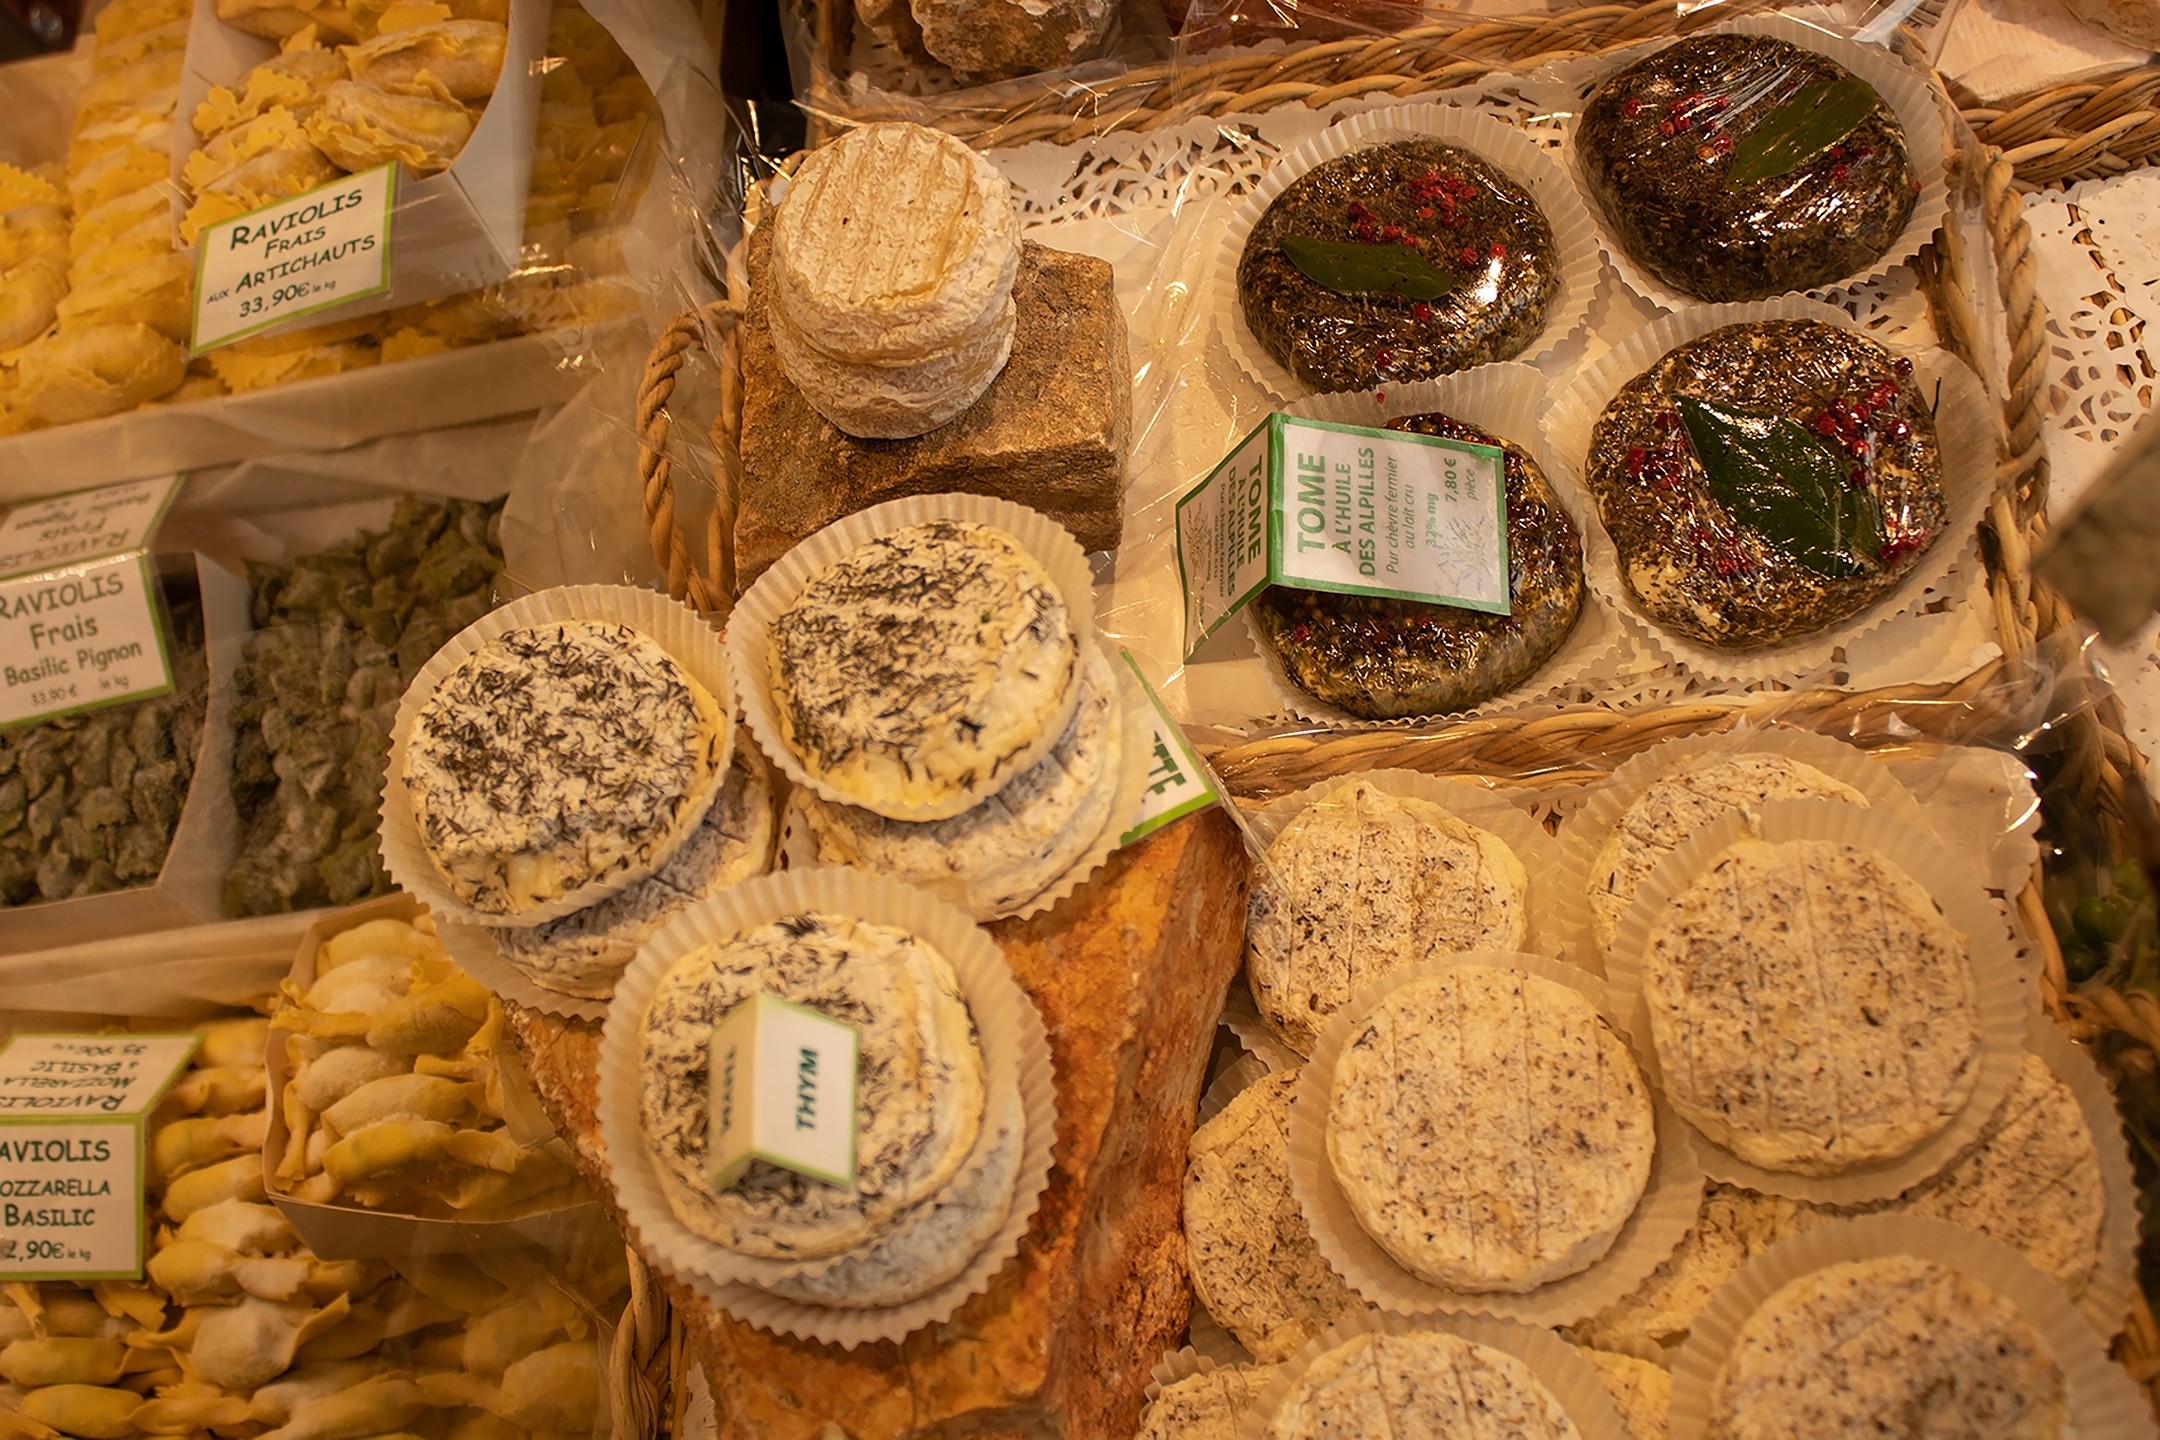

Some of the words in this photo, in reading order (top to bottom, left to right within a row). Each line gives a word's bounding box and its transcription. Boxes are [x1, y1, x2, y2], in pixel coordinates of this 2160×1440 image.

[230, 190, 362, 250] RAVIOLIS
[264, 226, 326, 259] FRAIS
[207, 289, 230, 304] AUX
[235, 235, 375, 293] ARTICHAUTS
[239, 282, 310, 318] 33,90€
[312, 285, 321, 294] le
[324, 280, 337, 290] kg
[1385, 456, 1398, 503] fermier
[1444, 458, 1456, 467] €
[1228, 466, 1237, 502] DES
[1335, 463, 1351, 535] L'HUILE
[1359, 448, 1375, 534] ALPILLES
[1405, 485, 1415, 504] cru
[1445, 471, 1459, 503] 7,80
[1465, 469, 1479, 500] pièce
[1248, 454, 1263, 564] TOME
[1297, 453, 1325, 552] TOME
[1402, 507, 1415, 532] lait
[1427, 493, 1439, 514] mg
[1237, 496, 1246, 570] L'HUILE
[1385, 505, 1398, 549] chèvre
[1404, 534, 1415, 549] au
[1228, 506, 1237, 596] ALPILLES
[1332, 539, 1351, 554] À
[1359, 540, 1376, 576] DES
[1386, 553, 1398, 574] Pur
[30, 614, 98, 650] Frais
[4, 657, 70, 687] Basilic
[76, 642, 142, 672] Pignon
[3, 1076, 137, 1089] MOZZARELLA
[31, 1061, 123, 1076] BASILIC
[796, 1047, 818, 1130] THYM
[4, 1204, 95, 1227] BASILIC
